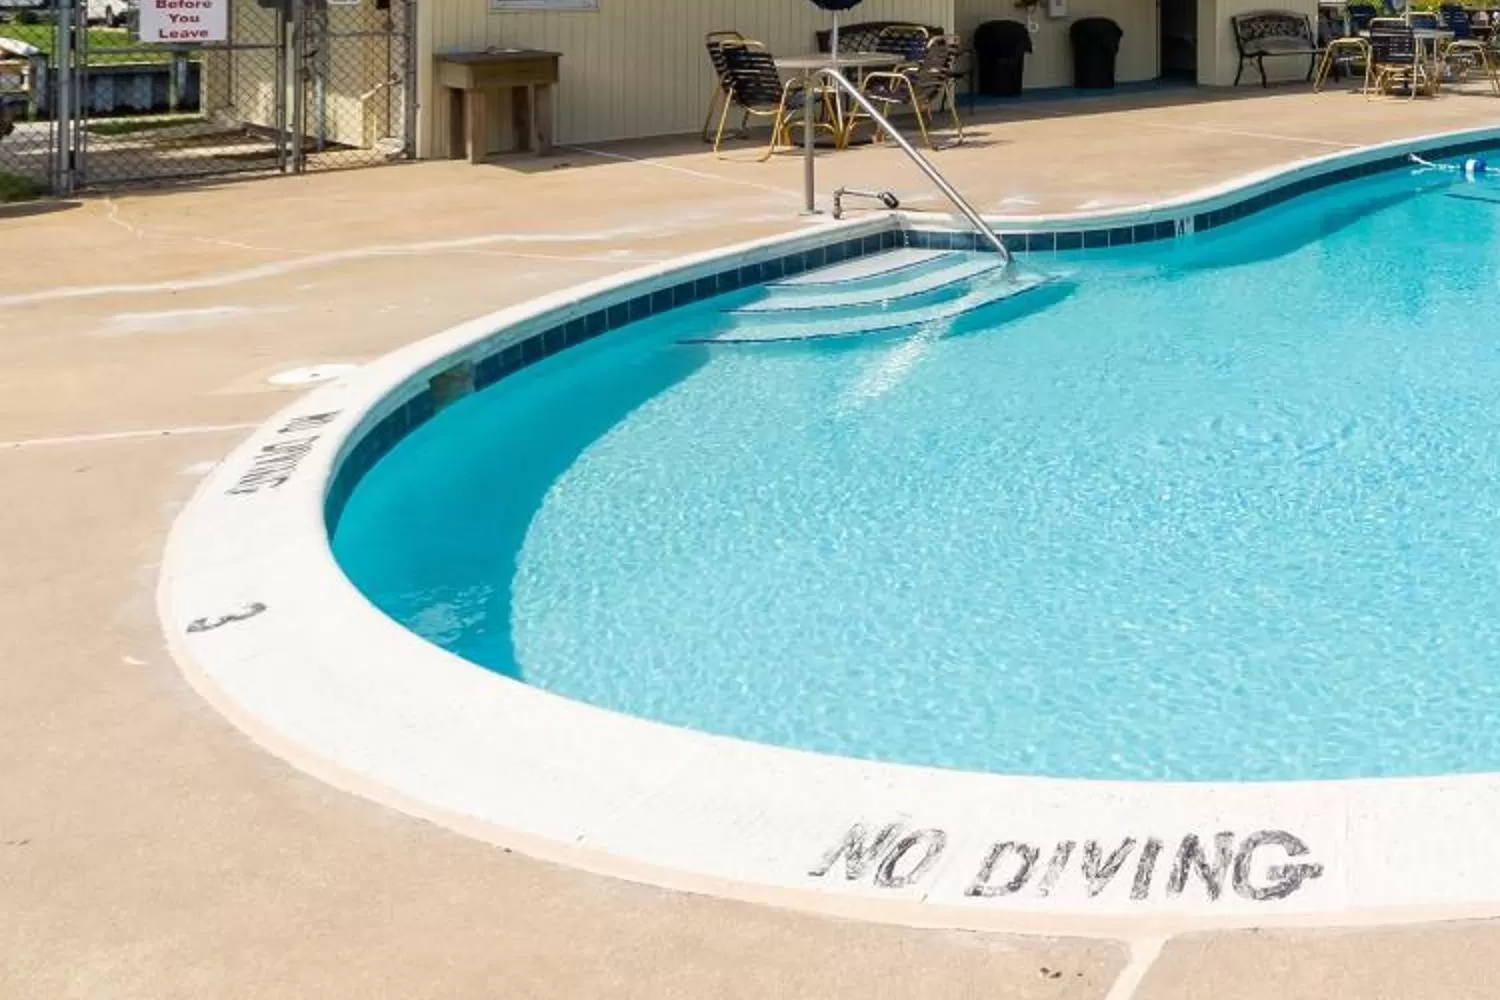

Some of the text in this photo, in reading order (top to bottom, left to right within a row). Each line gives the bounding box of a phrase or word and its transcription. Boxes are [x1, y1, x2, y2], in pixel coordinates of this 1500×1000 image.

[168, 13, 201, 23] You
[158, 28, 209, 38] Leave
[806, 820, 1325, 902] NO DIVING
